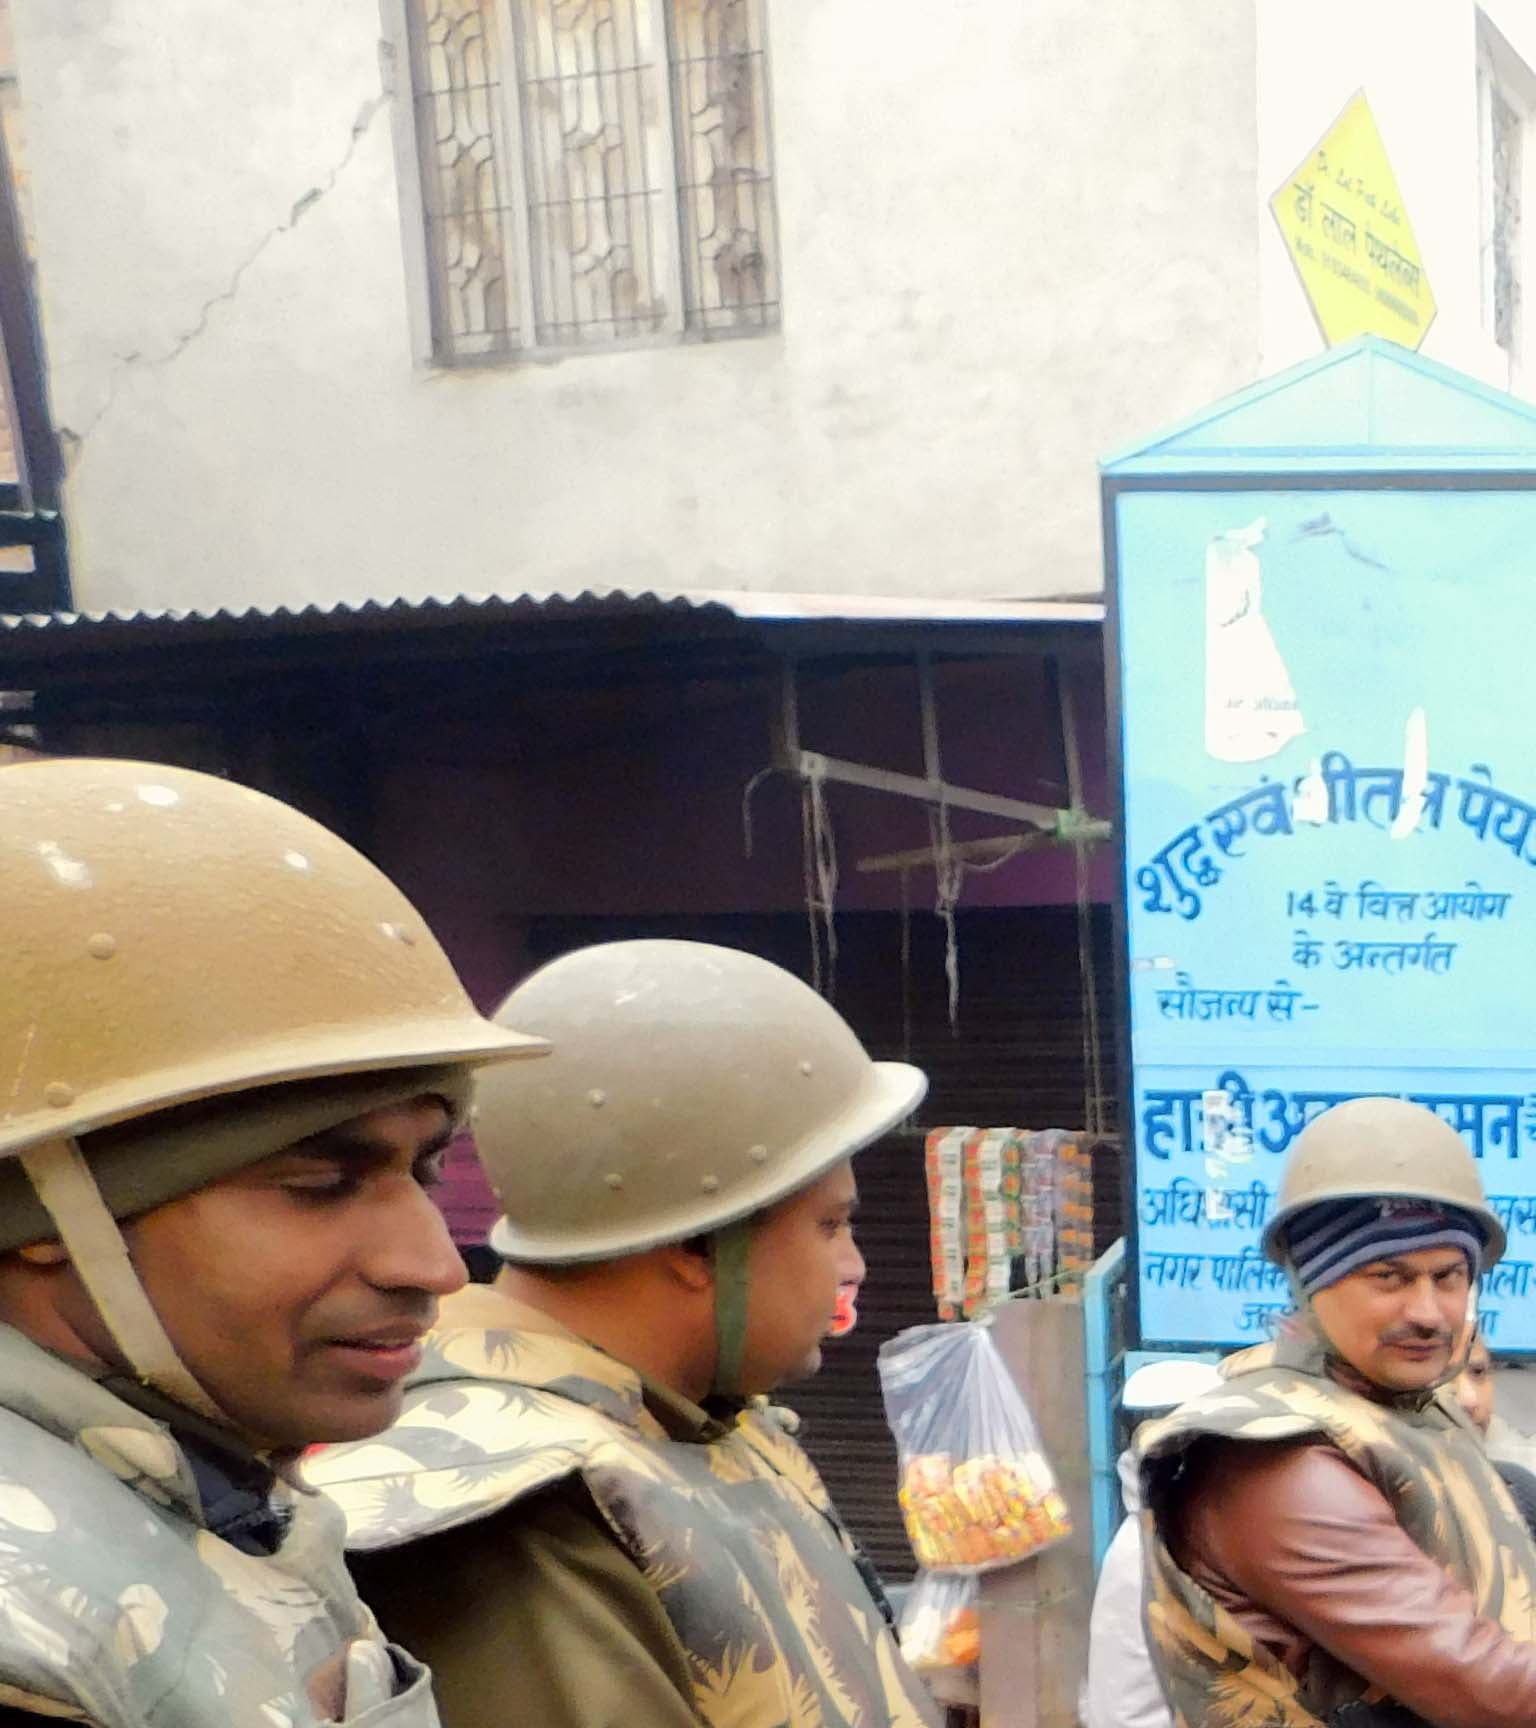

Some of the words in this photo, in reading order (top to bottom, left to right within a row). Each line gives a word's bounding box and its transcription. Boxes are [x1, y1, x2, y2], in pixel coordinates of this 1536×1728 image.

[1422, 880, 1512, 919] आयोग
[1292, 929, 1324, 969] के
[1333, 932, 1457, 974] अन्तर्गत
[1155, 970, 1262, 1021] सौजन्य
[1144, 1251, 1207, 1289] नगर
